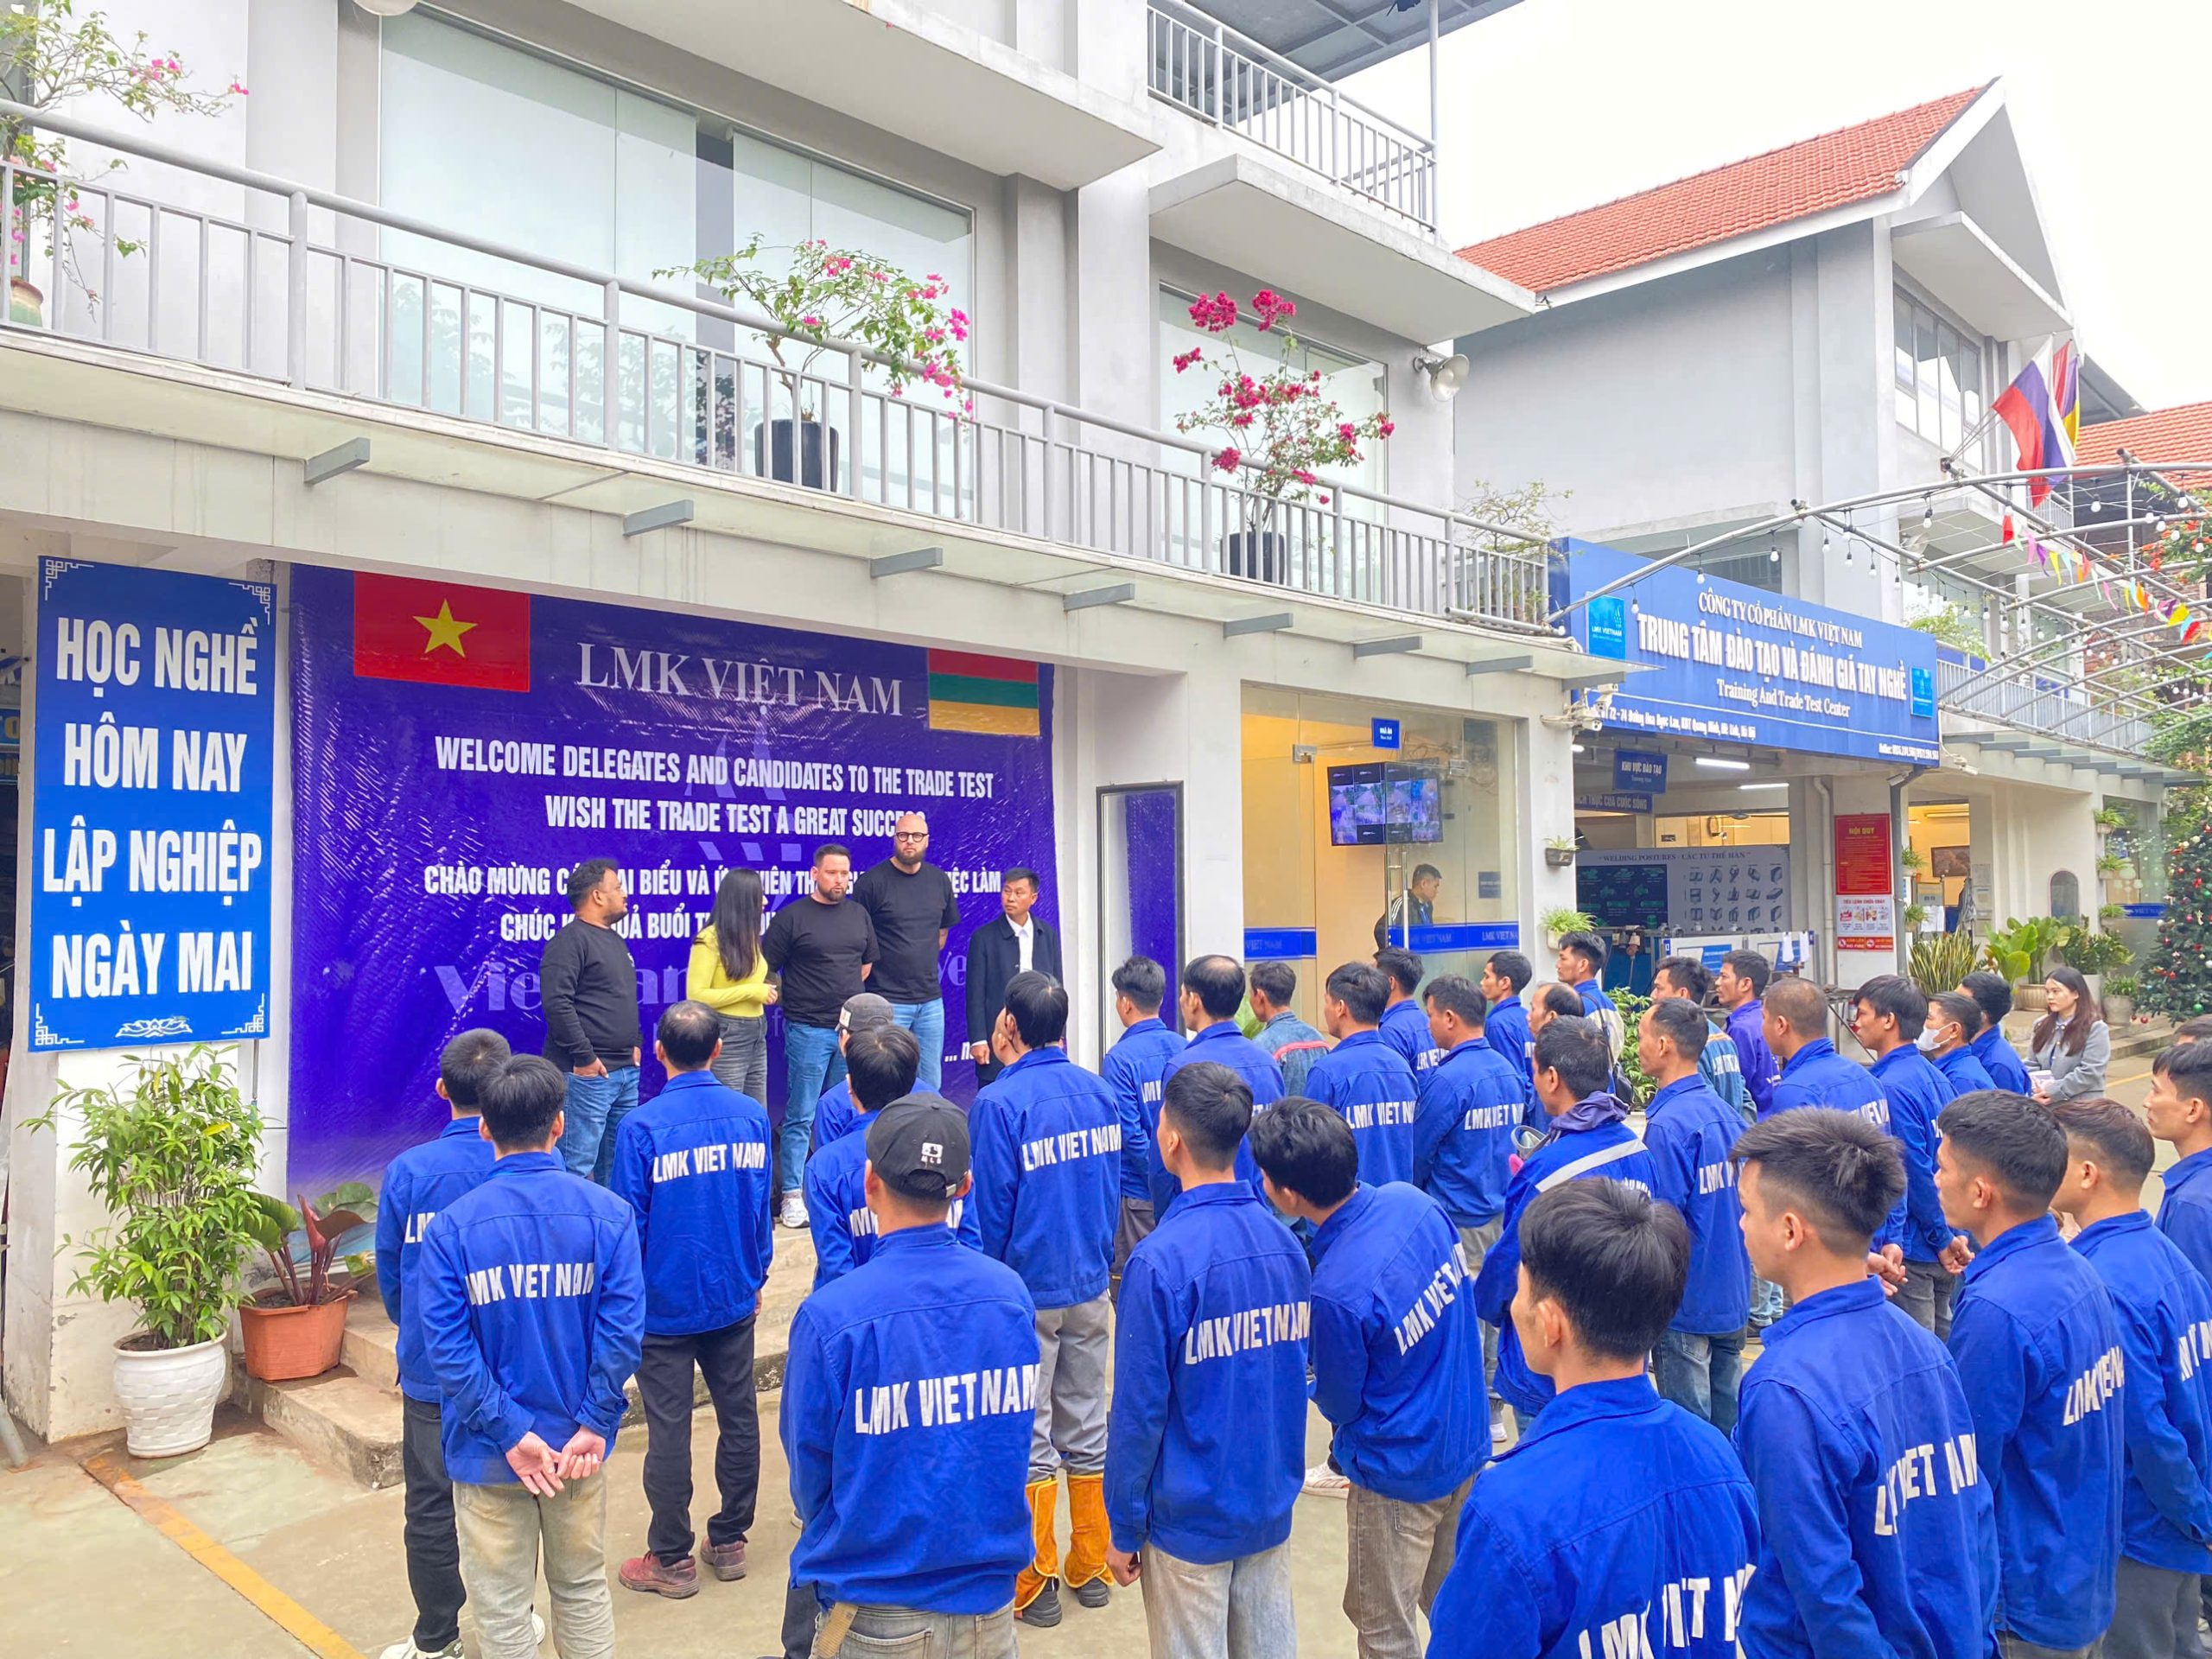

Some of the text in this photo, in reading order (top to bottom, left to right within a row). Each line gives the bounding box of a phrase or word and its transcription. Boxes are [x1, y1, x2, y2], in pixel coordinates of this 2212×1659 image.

[1698, 588, 1731, 617] CÔNG
[1732, 601, 1747, 621] TY
[1793, 615, 1816, 638] LMK
[1815, 620, 1840, 646] VIỆT
[1840, 626, 1863, 648] NAM
[56, 616, 258, 697] HỌC NGHỀ
[575, 642, 903, 716] LMK VIỆT NAM
[1637, 613, 1907, 701] TRUNG TÂM ĐÀO TẠO VÀ ĐÁNH GIÁ TAY NGHỀ
[1717, 678, 1851, 718] Training And Trade Test Center
[64, 712, 248, 792] HÔM NAY
[435, 735, 995, 798] WELCOME DELEGATES AND CANDIDATES TO THE TRADE TEST
[545, 795, 925, 837] WISH THE TRADE TEST A GREAT SUCC
[42, 815, 262, 907] LẬP NGHIỆP
[424, 861, 481, 895] CHÀO
[487, 861, 550, 895] MỪNG
[639, 859, 682, 895] BIỂU
[686, 865, 710, 895] VÀ
[972, 866, 1001, 893] LÀM
[1604, 852, 1676, 862] WELDING POSTURES
[500, 908, 556, 941] CHÚC
[647, 903, 690, 938] BUỔI
[1482, 931, 1495, 941] LMK
[51, 920, 252, 1000] NGÀY MAI
[1346, 1103, 1374, 1129] LMK
[1465, 1108, 1492, 1130] LMK
[652, 1142, 766, 1184] LMK VIET NAM
[1021, 1123, 1122, 1172] LMK VIET NAM
[1699, 1162, 1725, 1194] LMK
[1185, 1316, 1233, 1364] LMK
[1233, 1307, 1273, 1352] VIET
[1394, 1297, 1435, 1356] LMK
[855, 1363, 1040, 1435] LMK VIET NAM
